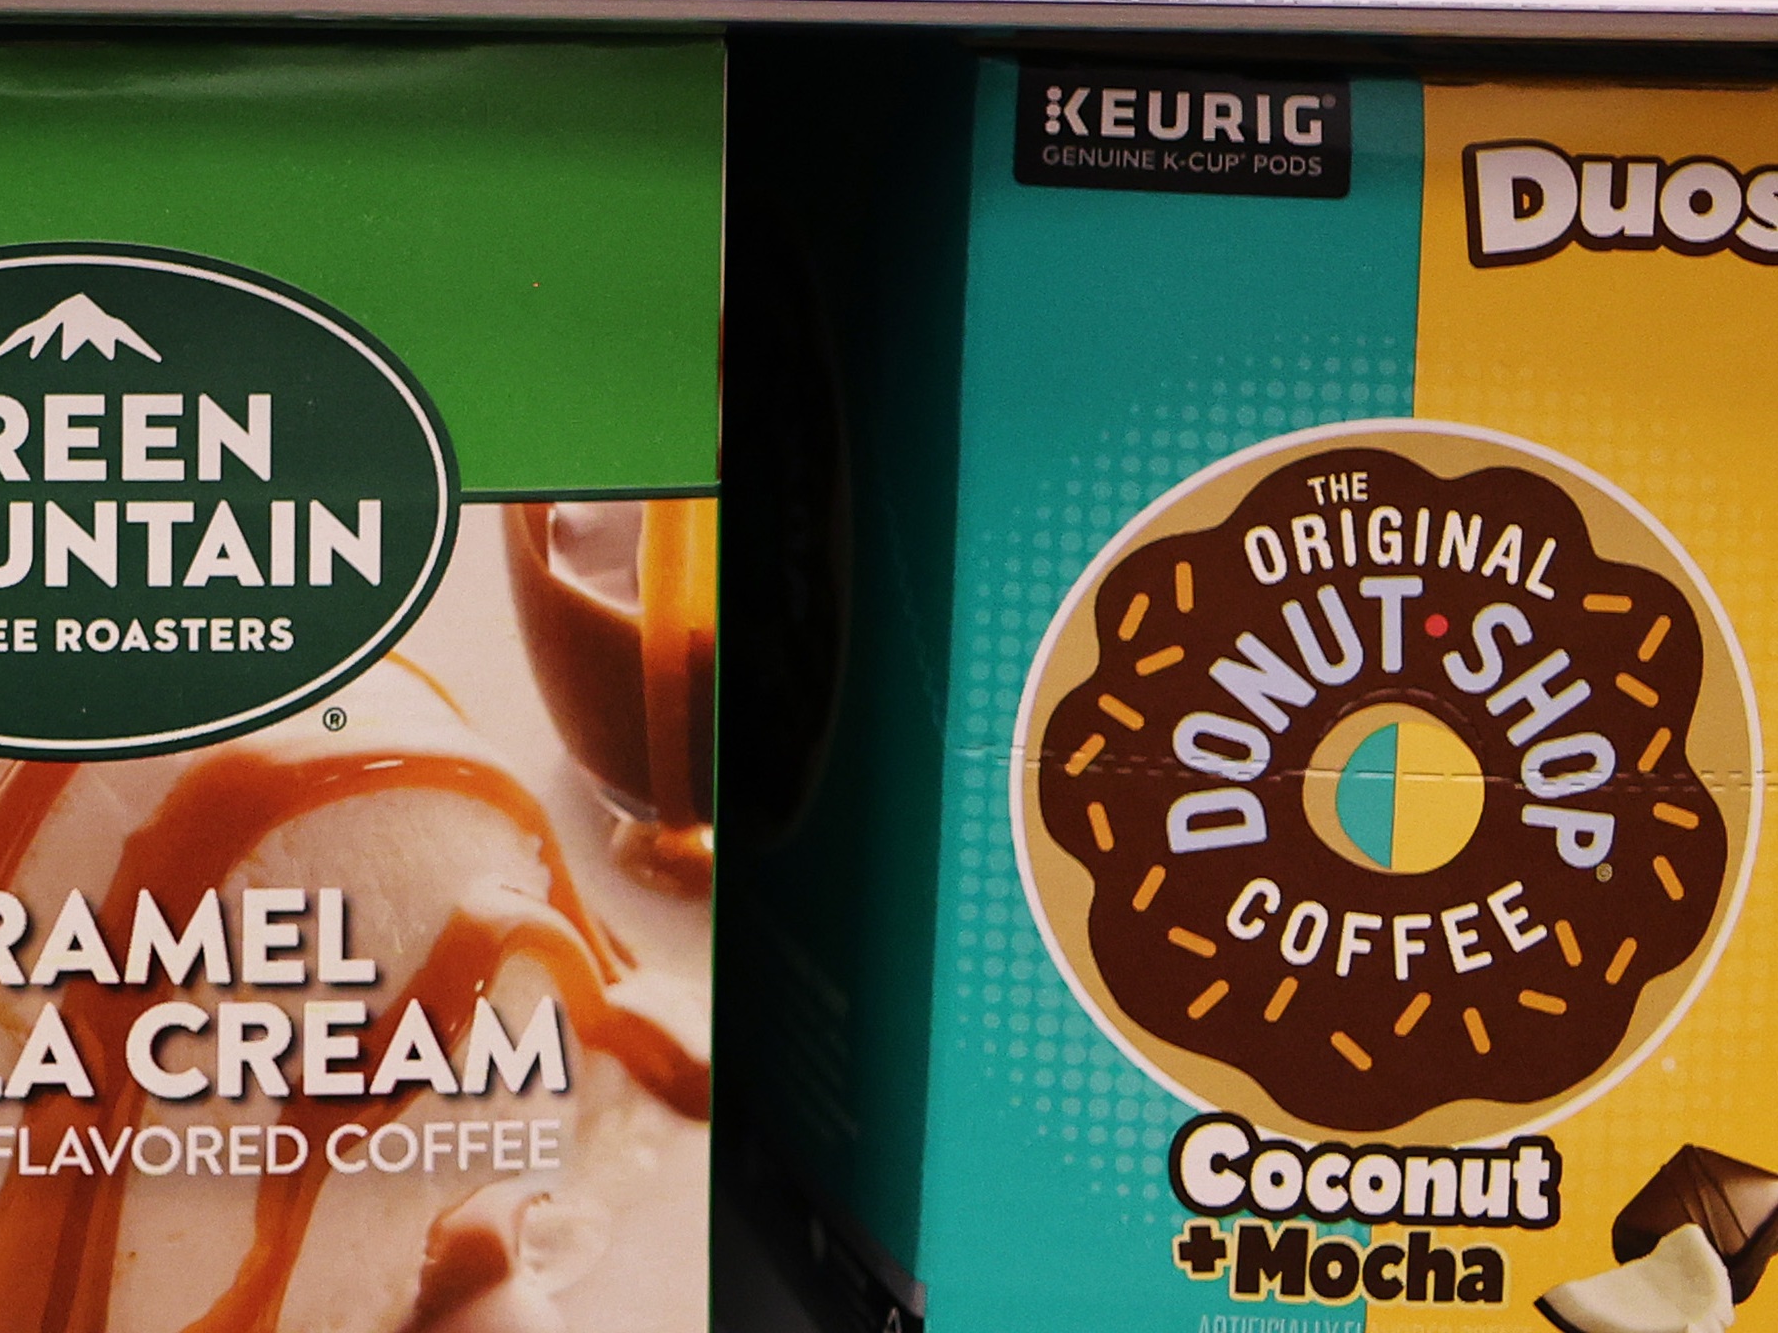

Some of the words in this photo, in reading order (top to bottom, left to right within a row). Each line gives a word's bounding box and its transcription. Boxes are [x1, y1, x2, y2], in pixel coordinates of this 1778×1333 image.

[1469, 142, 1778, 261] Duos
[1307, 472, 1369, 504] THE
[1244, 505, 1559, 600] ORIGINAL
[55, 619, 294, 653] ROASTERS
[1166, 575, 1425, 854] DONUT
[1225, 877, 1549, 981] COFFEE
[126, 995, 568, 1099] CREAM
[325, 1119, 561, 1174] COFFEE
[1176, 1118, 1554, 1223] Coconut
